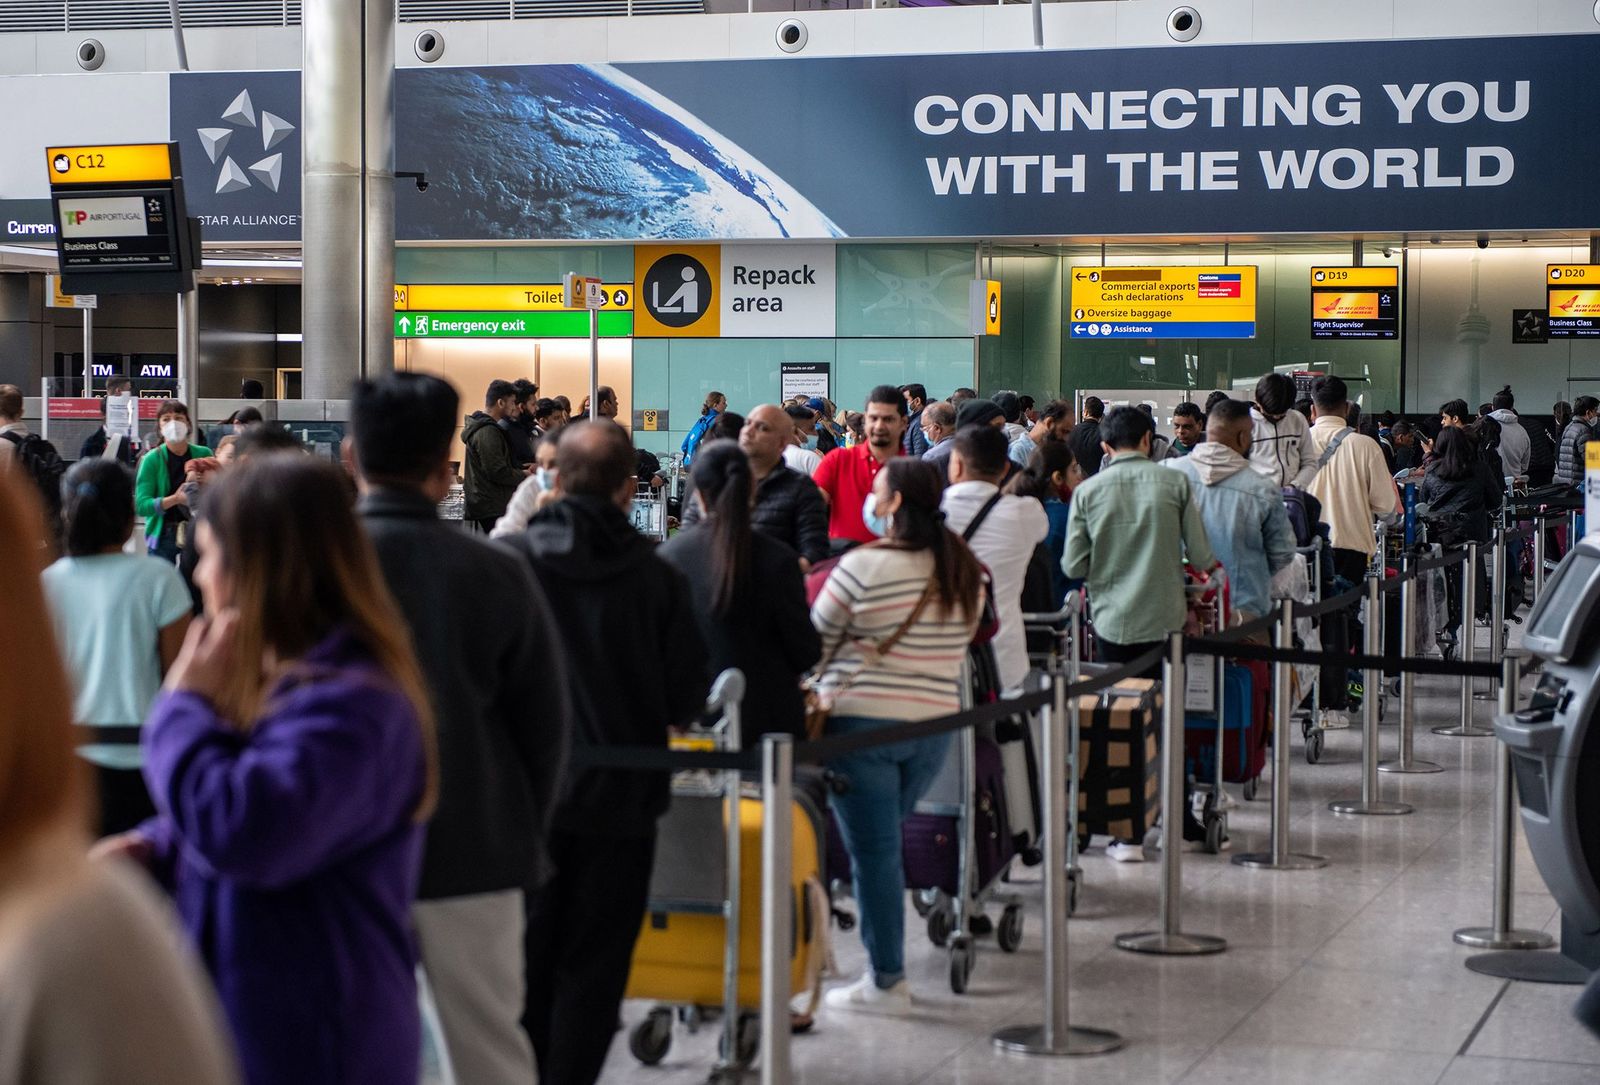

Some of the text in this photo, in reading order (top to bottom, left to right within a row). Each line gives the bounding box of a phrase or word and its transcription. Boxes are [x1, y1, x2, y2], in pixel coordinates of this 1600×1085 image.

[914, 80, 1531, 136] CONNECTING YOU
[76, 154, 105, 168] C12
[925, 145, 1516, 196] WITH THE WORLD
[197, 214, 297, 225] STAR ALLIANCE
[63, 241, 118, 251] Business Class
[733, 264, 816, 290] Repack
[1328, 271, 1348, 280] D19
[1565, 269, 1585, 277] D20
[1101, 282, 1196, 292] Commercial exports
[1101, 292, 1184, 301] Cash declarations
[732, 297, 783, 312] area
[1087, 308, 1172, 319] Oversize baggage
[432, 319, 525, 333] Emergency exit
[1113, 325, 1153, 333] Assistance
[1313, 321, 1364, 329] Flight Supervisor
[82, 364, 113, 376] TM
[140, 364, 171, 376] ATM
